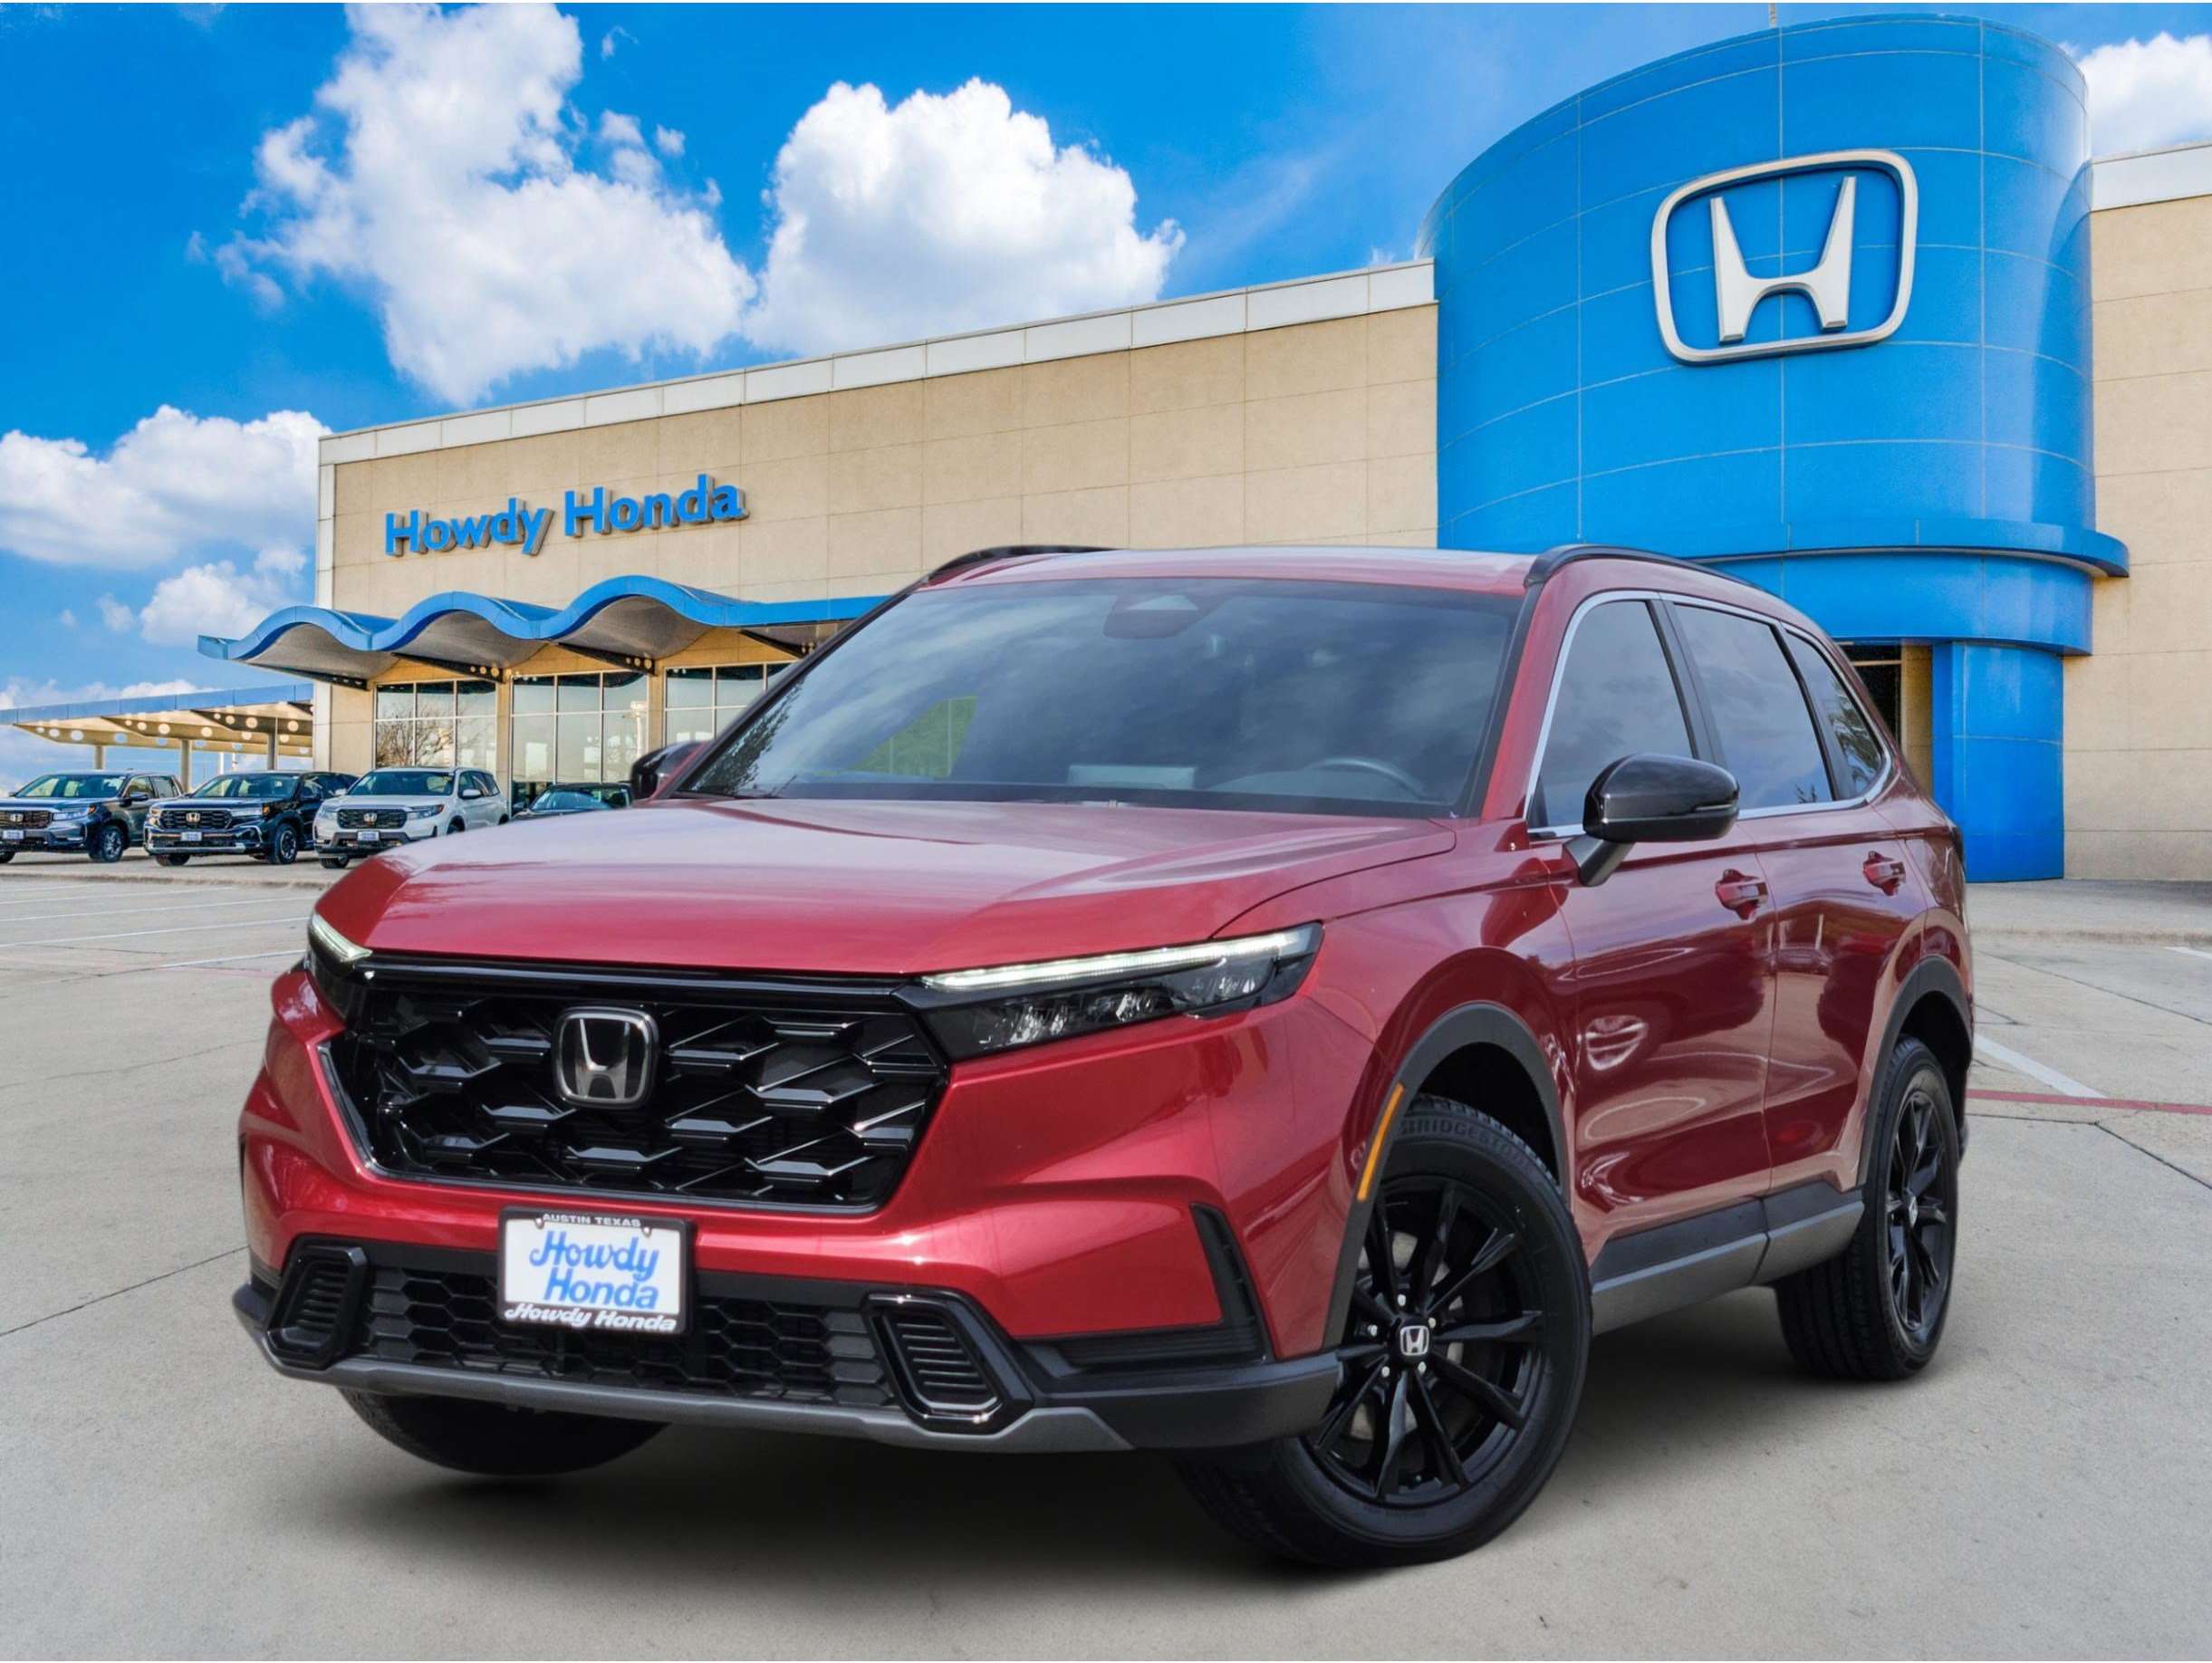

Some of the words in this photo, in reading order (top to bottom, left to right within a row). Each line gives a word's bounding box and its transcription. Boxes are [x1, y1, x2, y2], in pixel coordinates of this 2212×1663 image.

[385, 497, 552, 556] Howdy
[564, 474, 748, 538] Honda
[1399, 1118, 1531, 1171] BRIDGESTO
[543, 1213, 591, 1225] AUSTIN
[594, 1216, 641, 1227] TEXAS
[529, 1230, 659, 1282] Howdy
[544, 1267, 659, 1309] Honda
[505, 1303, 591, 1327] Howdy
[594, 1310, 677, 1331] Honda
